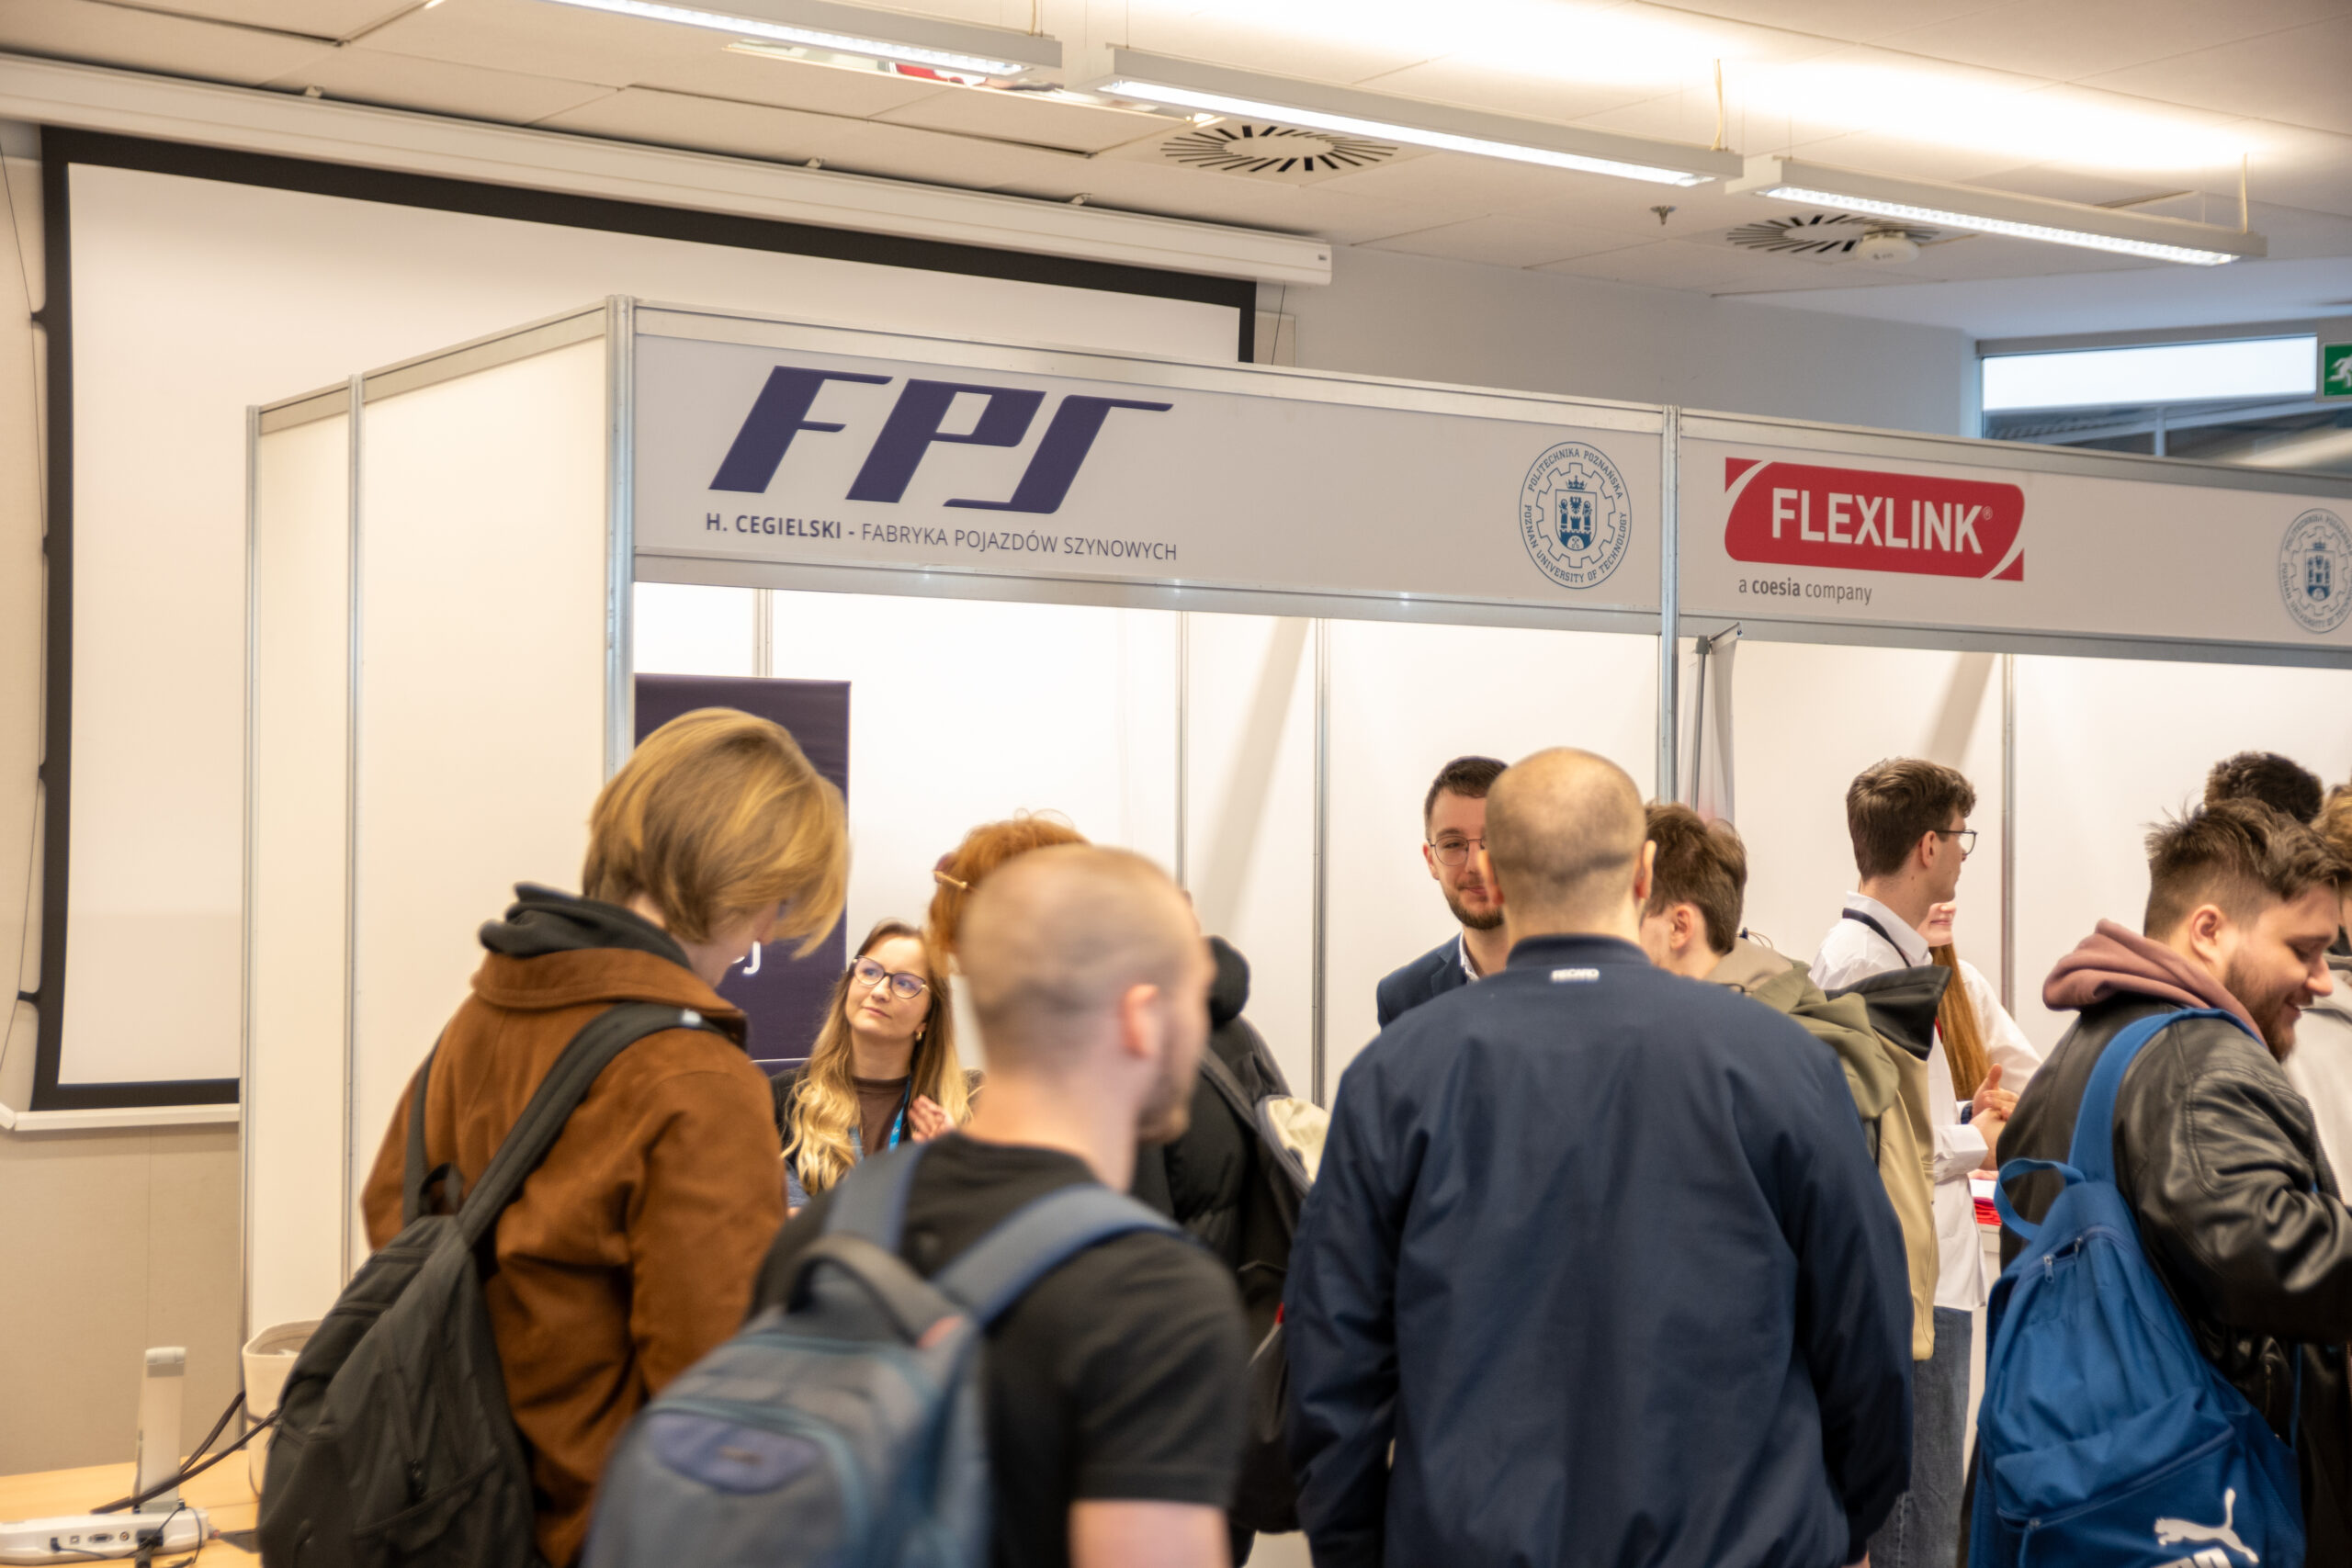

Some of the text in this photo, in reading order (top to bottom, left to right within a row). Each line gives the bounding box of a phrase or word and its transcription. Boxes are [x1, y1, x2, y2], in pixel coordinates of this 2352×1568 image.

[708, 366, 1174, 514] FPS
[1528, 447, 1623, 500] POLITECHNIKA POZNAŃSKA
[706, 512, 728, 532] H.
[736, 514, 842, 539] CEGIELSKI
[862, 523, 948, 547] FABRYKA
[955, 529, 1058, 553] POJAZDÓW
[1064, 536, 1177, 561] SZYNOWYCH
[1524, 504, 1627, 583] POZNAN UNIVERSITY OF TECHNOLOGY
[1738, 577, 1872, 606] a coesia company
